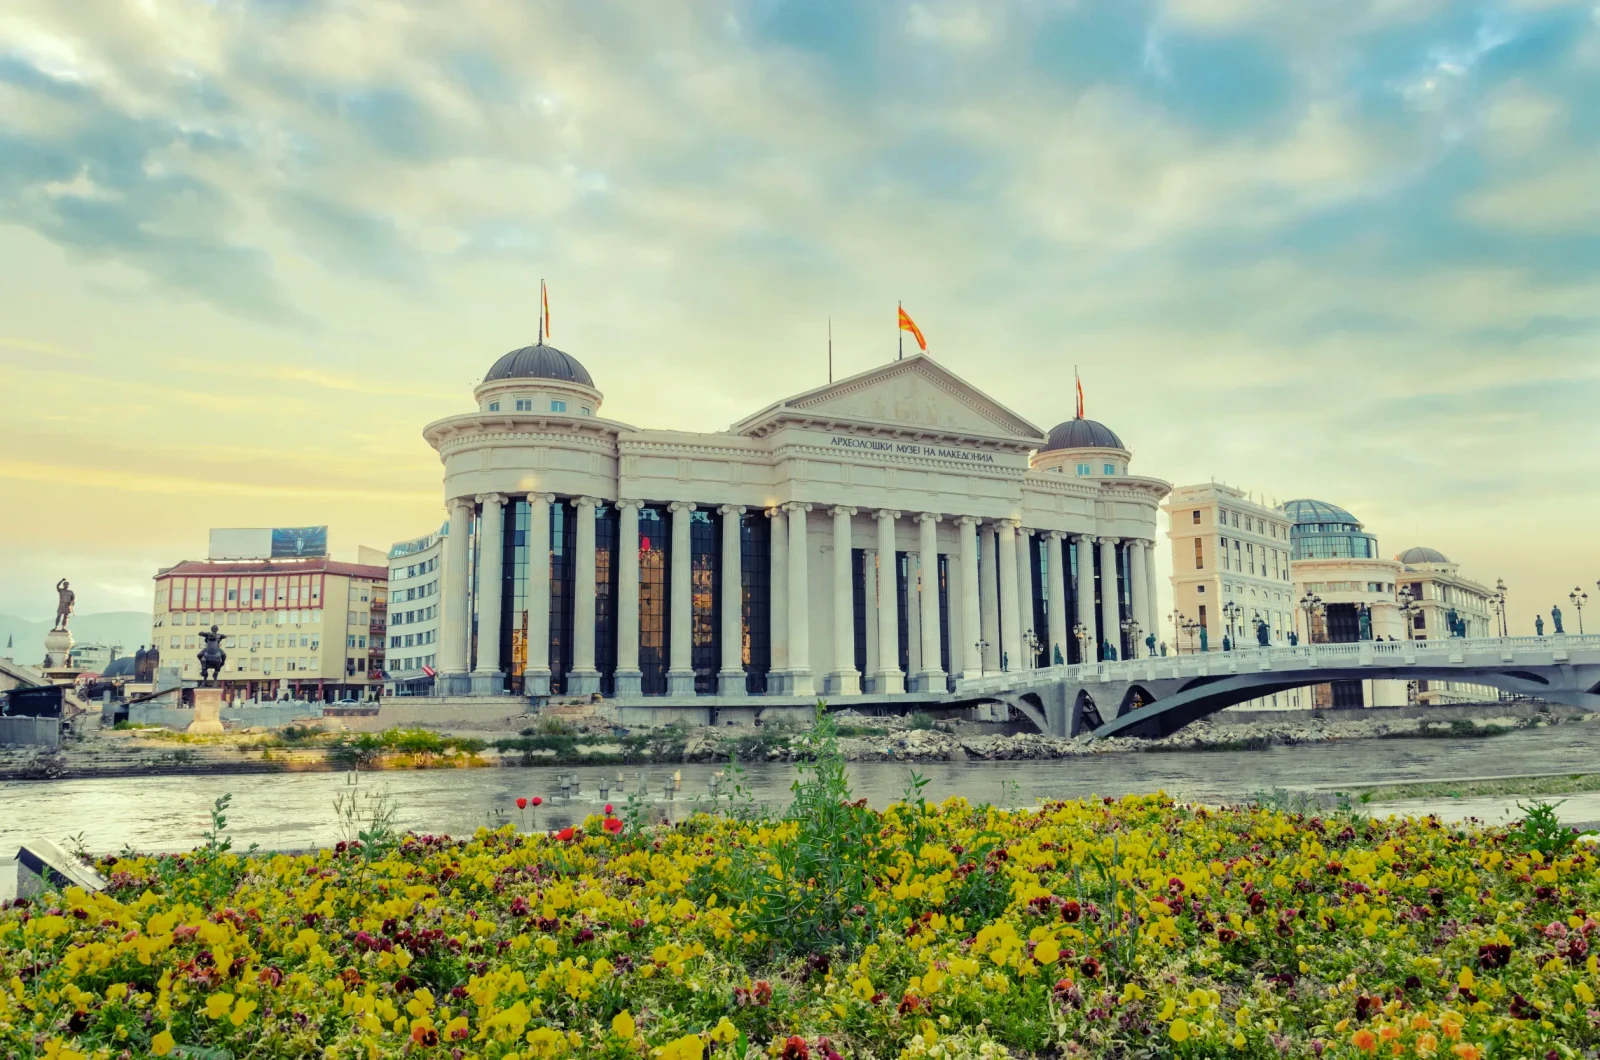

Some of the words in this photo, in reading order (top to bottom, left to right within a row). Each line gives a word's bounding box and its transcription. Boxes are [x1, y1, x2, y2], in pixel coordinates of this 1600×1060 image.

[831, 437, 893, 452] АРХЕОЛОШКИ
[896, 444, 920, 454] МУЗЕЈ
[923, 447, 936, 456] НА
[938, 449, 993, 463] МАКЕДОНИЈА
